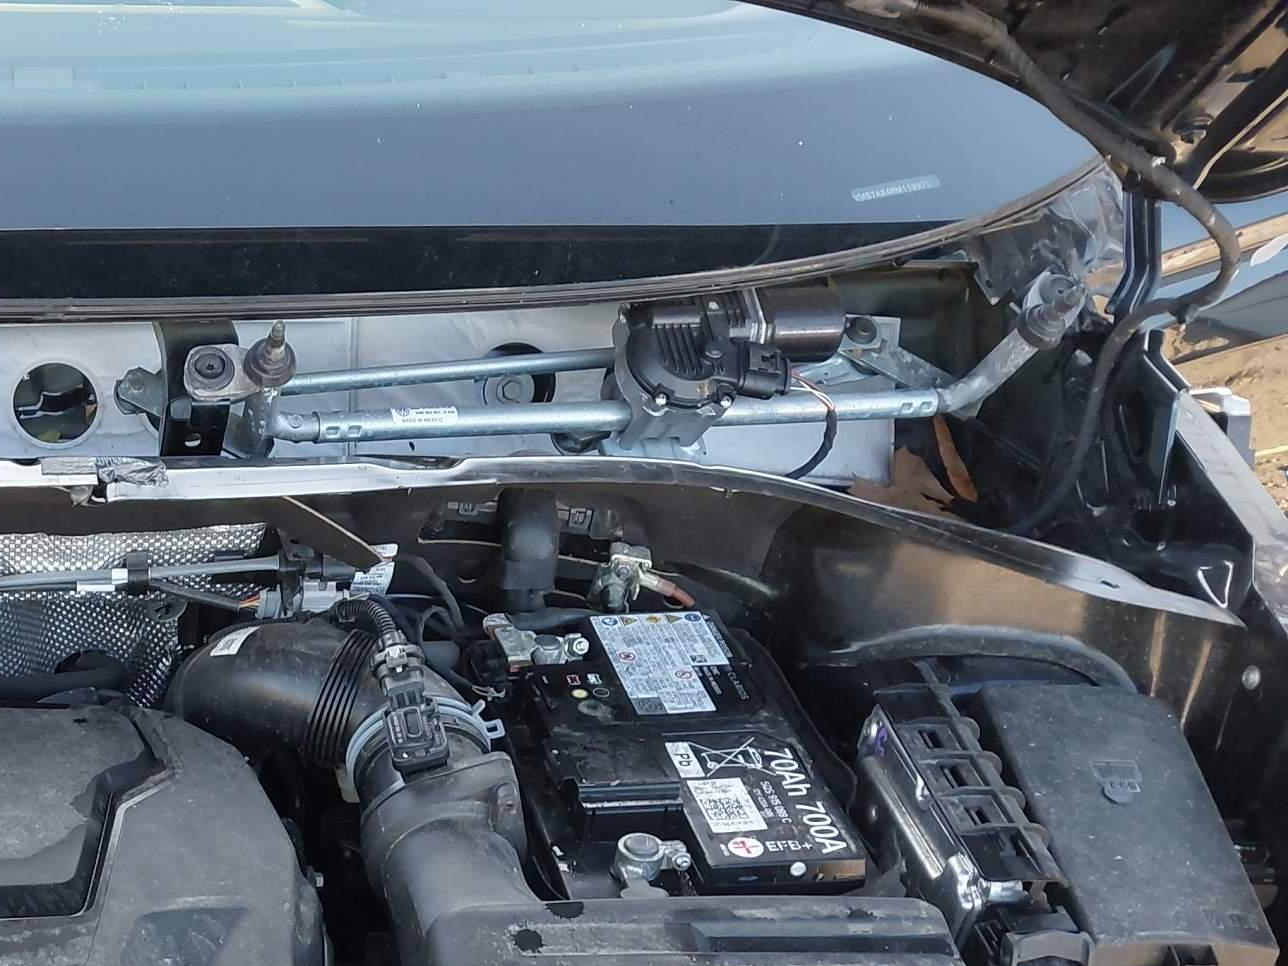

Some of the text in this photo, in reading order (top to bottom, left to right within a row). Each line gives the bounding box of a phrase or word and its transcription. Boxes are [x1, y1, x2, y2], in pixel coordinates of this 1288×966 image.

[678, 753, 691, 767] Pb
[764, 748, 848, 854] 70Ah 700A
[765, 840, 813, 852] EFB+
